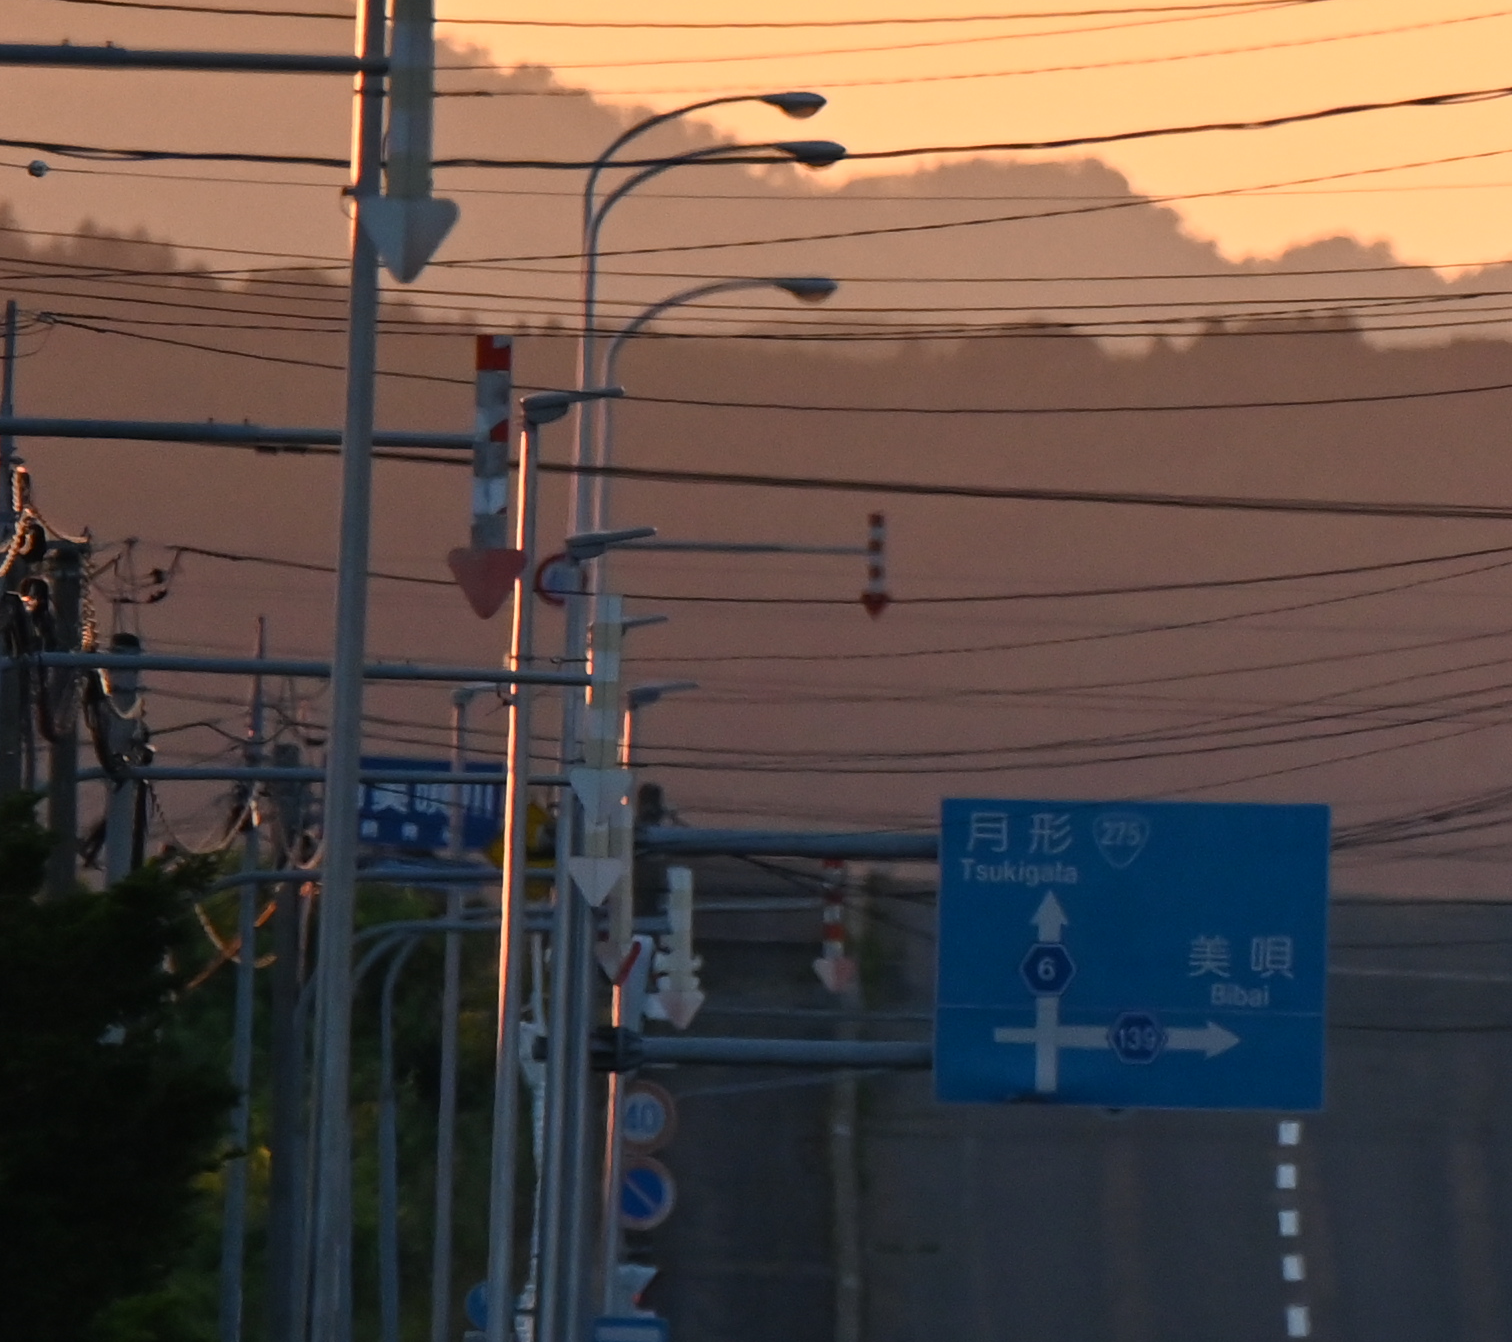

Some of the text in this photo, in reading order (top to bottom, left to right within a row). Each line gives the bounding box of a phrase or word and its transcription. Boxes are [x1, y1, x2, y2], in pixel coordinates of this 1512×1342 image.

[966, 812, 1074, 855] 月形
[1099, 821, 1142, 847] 275
[960, 858, 1079, 886] Tsukigata
[1037, 956, 1055, 981] 6
[1188, 934, 1295, 980] 美唄
[1210, 983, 1270, 1008] Bibai
[1118, 1024, 1157, 1051] 139
